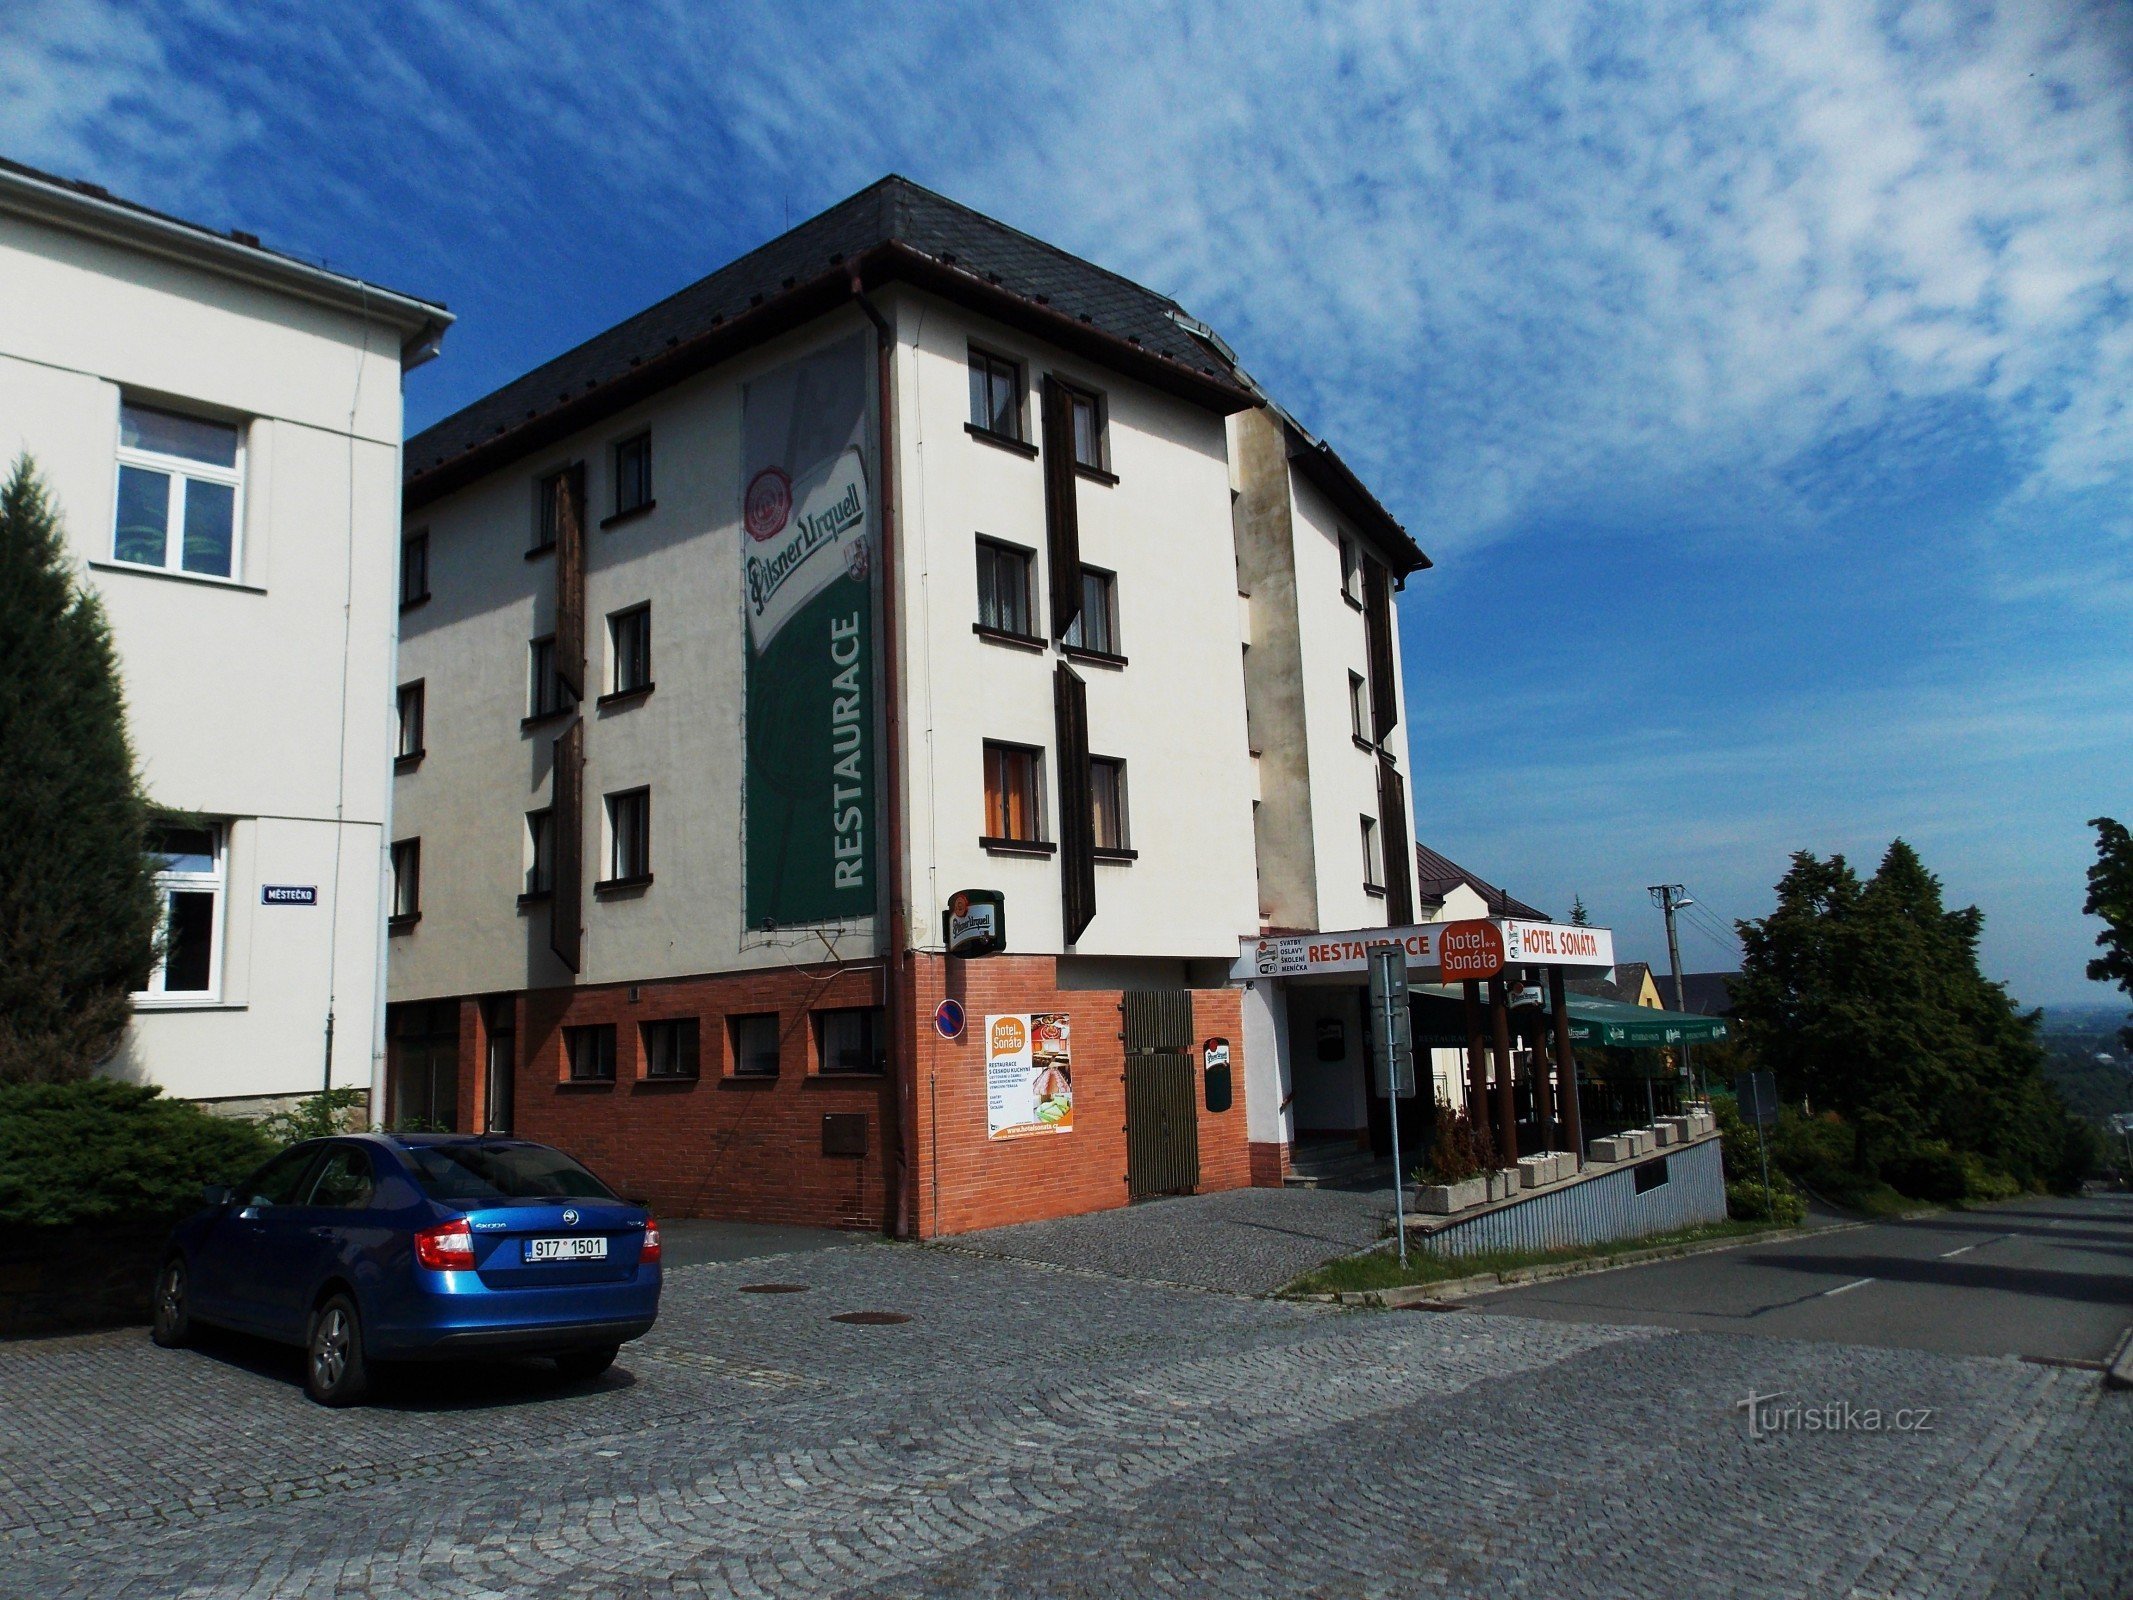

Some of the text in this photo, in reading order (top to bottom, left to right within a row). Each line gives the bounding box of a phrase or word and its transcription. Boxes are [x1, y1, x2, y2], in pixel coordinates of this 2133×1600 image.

[747, 533, 802, 616] Pilsner
[798, 482, 861, 547] Urquell
[831, 610, 863, 889] RESTAURACE
[268, 889, 312, 900] MĚSTEČKO
[1446, 930, 1485, 950] hotel
[1522, 929, 1598, 957] HOTEL SONÁTA
[1281, 964, 1308, 972] MENÍČKA
[1445, 951, 1497, 970] Sonáta
[995, 1023, 1016, 1036] hotel
[994, 1037, 1022, 1049] Sonáta
[535, 1239, 601, 1257] 9T7 1501
